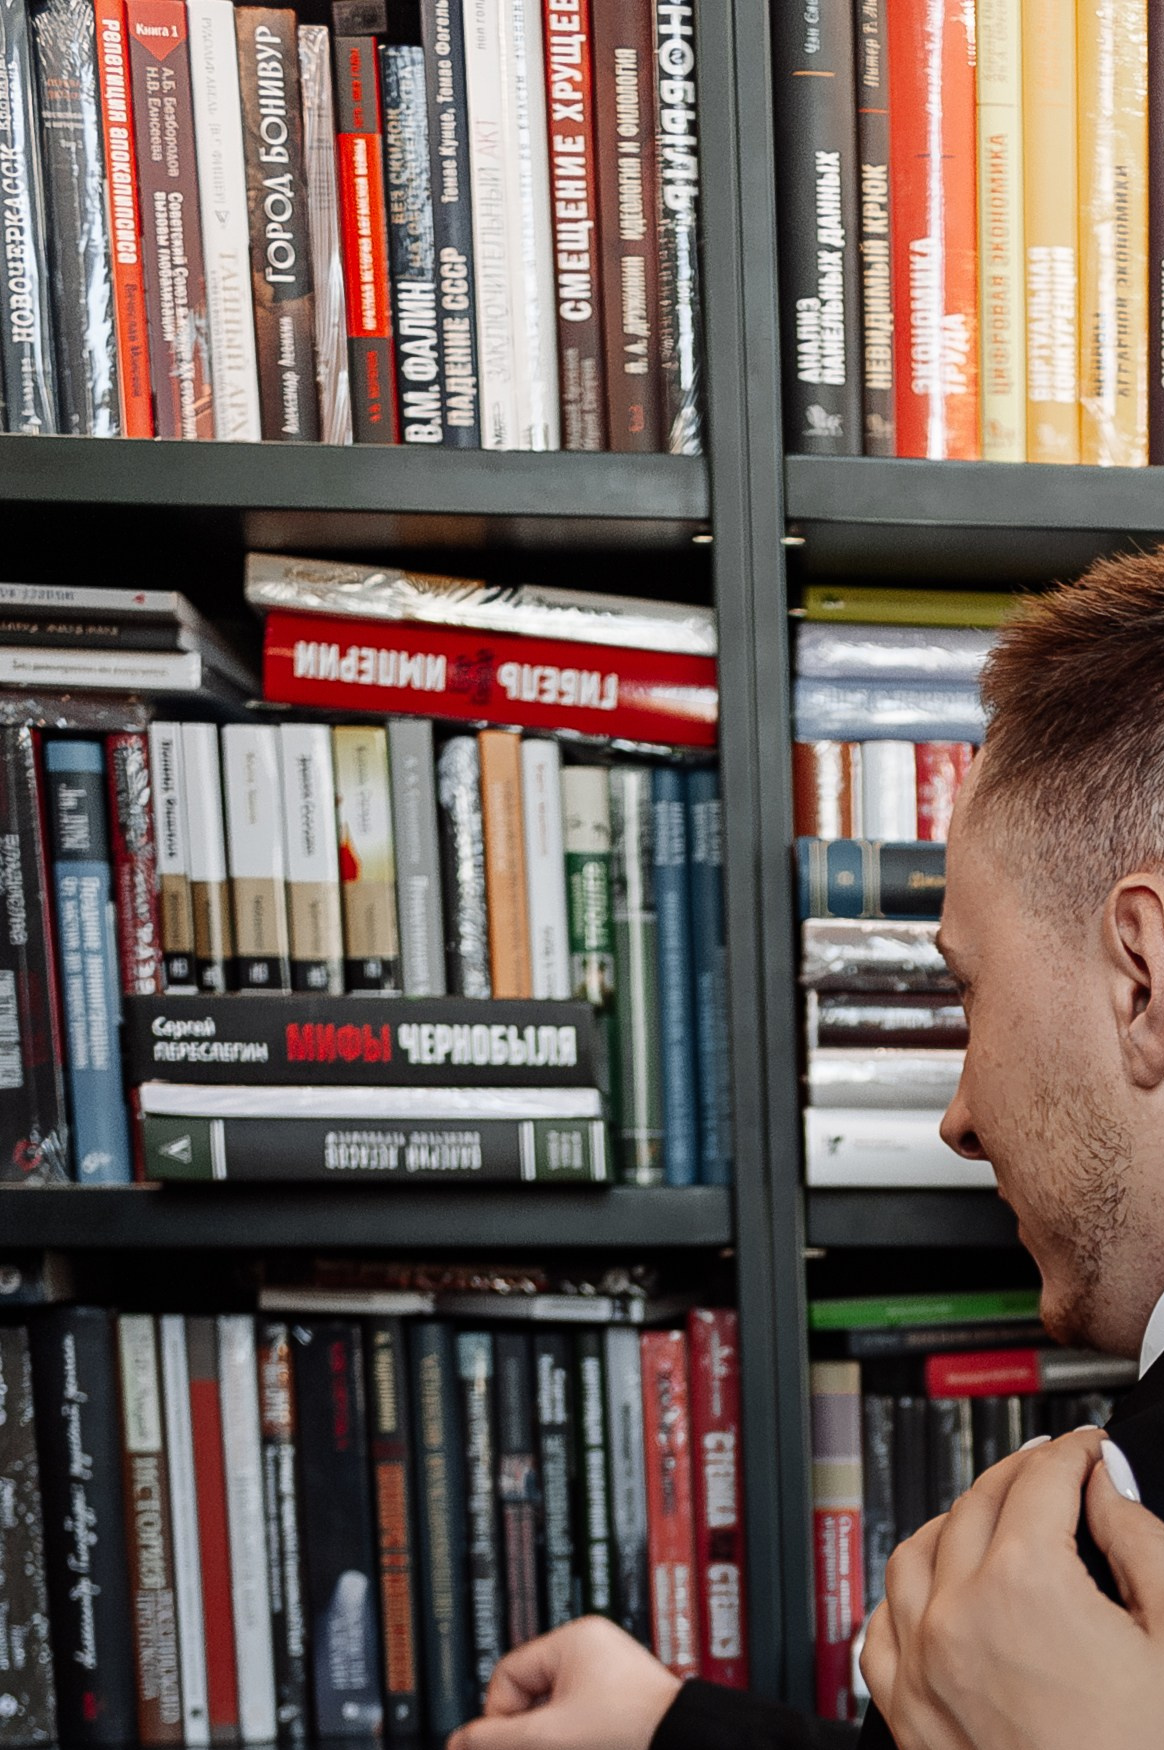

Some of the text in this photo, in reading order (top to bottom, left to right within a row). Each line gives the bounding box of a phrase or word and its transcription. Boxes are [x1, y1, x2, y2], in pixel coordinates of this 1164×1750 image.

[135, 24, 179, 39] Книга 1
[862, 38, 882, 88] Питер
[145, 66, 165, 162] Н.В. Елисеева
[159, 67, 181, 178] А.Б. Безбородов
[435, 58, 455, 103] Томас
[657, 0, 699, 213] НОБЫЛЬ
[255, 23, 297, 283] ГОРОД БОНИВУР
[384, 107, 408, 225] БЕЗ СКИДОК
[438, 106, 460, 156] Кунце,
[474, 117, 500, 161] АКТ
[612, 47, 648, 241] ИДЕОЛОГИЯ И ФИЛОЛОГИЯ
[153, 191, 171, 246] вызовы
[167, 192, 188, 265] Советский
[441, 158, 460, 204] Томас
[550, 134, 596, 323] СМЕЩЕНИЕ
[1, 141, 35, 344] НОВОЧЕРКАССК
[173, 267, 189, 305] Союз
[814, 150, 847, 386] ПАНЕЛЬНЫХ ДАННЫХ
[858, 163, 895, 391] НЕВИДИМЫЙ КРЮК
[985, 132, 1015, 395] ЦИФРОВАЯ ЭКОНОМИКА
[396, 280, 444, 443] В.М. ФАЛИН
[439, 246, 478, 428] ПАДЕНИЕ СССР
[795, 296, 822, 385] АНАЛИЗ
[908, 237, 942, 397] ЭКОНОМИКА
[940, 313, 971, 396] ТРУДА
[1027, 246, 1055, 402] ВИРТУАЛЬНАЯ
[1053, 246, 1079, 404] КОНКУРЕНЦИЯ
[292, 640, 619, 712] ГИБЕЛЬ ИМПЕРИИ
[151, 1016, 216, 1040] Сергей
[152, 1039, 270, 1065] ПЕРЕСЛЕГИН
[286, 1022, 578, 1069] МИФЫ ЧЕРНОБЫЛЯ
